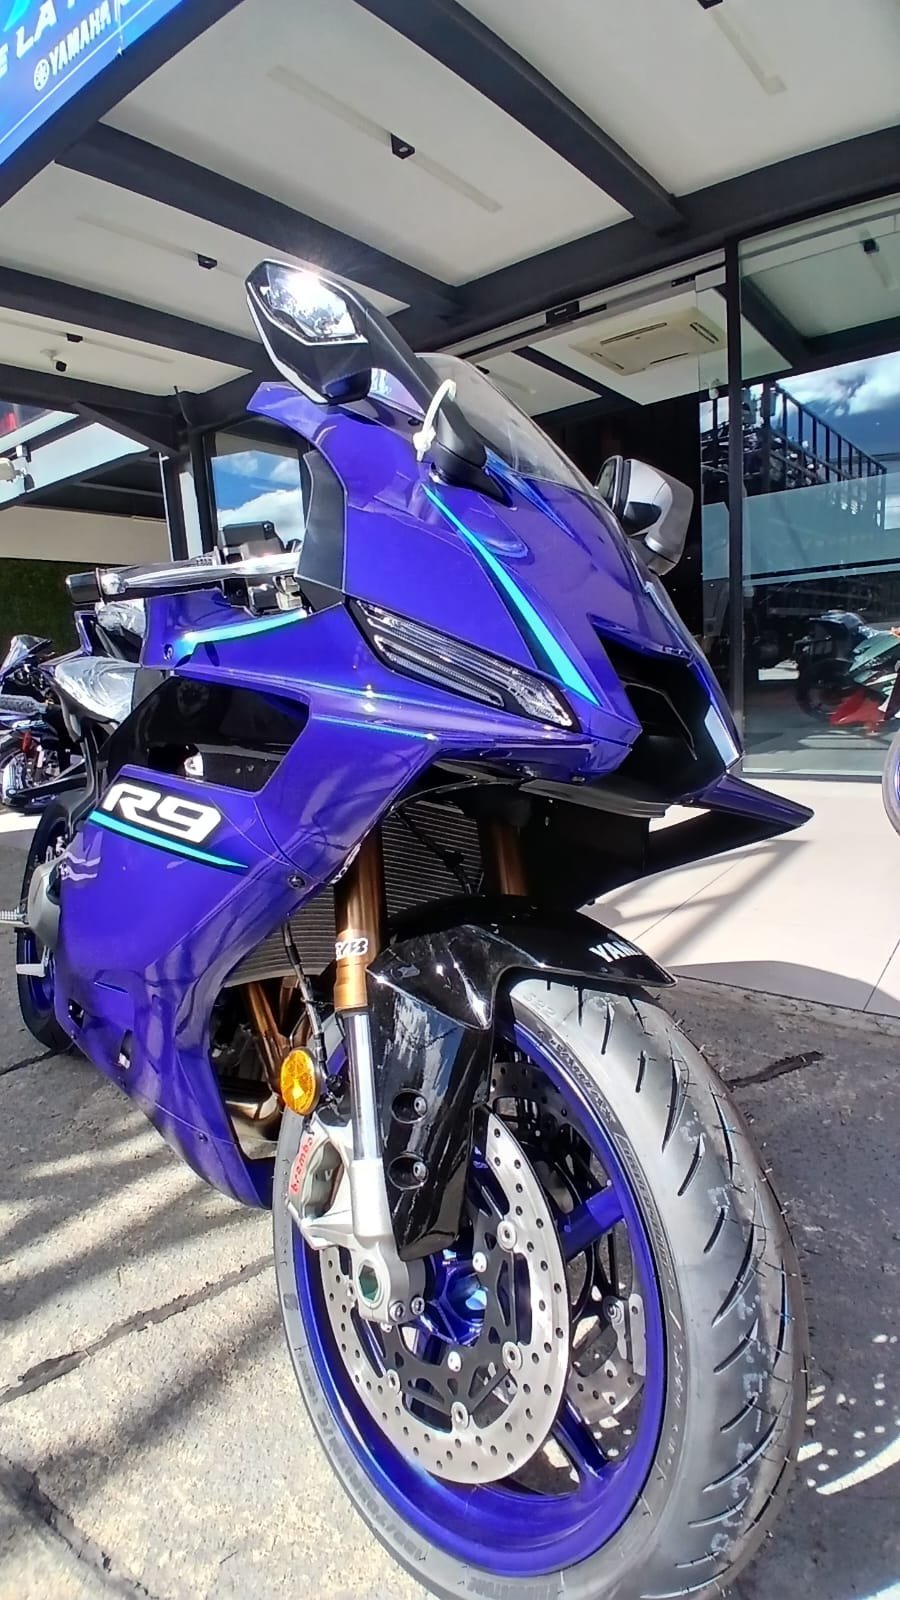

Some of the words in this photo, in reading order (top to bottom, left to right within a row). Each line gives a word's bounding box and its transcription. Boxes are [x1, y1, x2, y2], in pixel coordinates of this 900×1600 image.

[16, 0, 57, 59] LA
[49, 0, 112, 76] YAMAHA
[101, 783, 222, 843] R9
[290, 1136, 313, 1194] brembo
